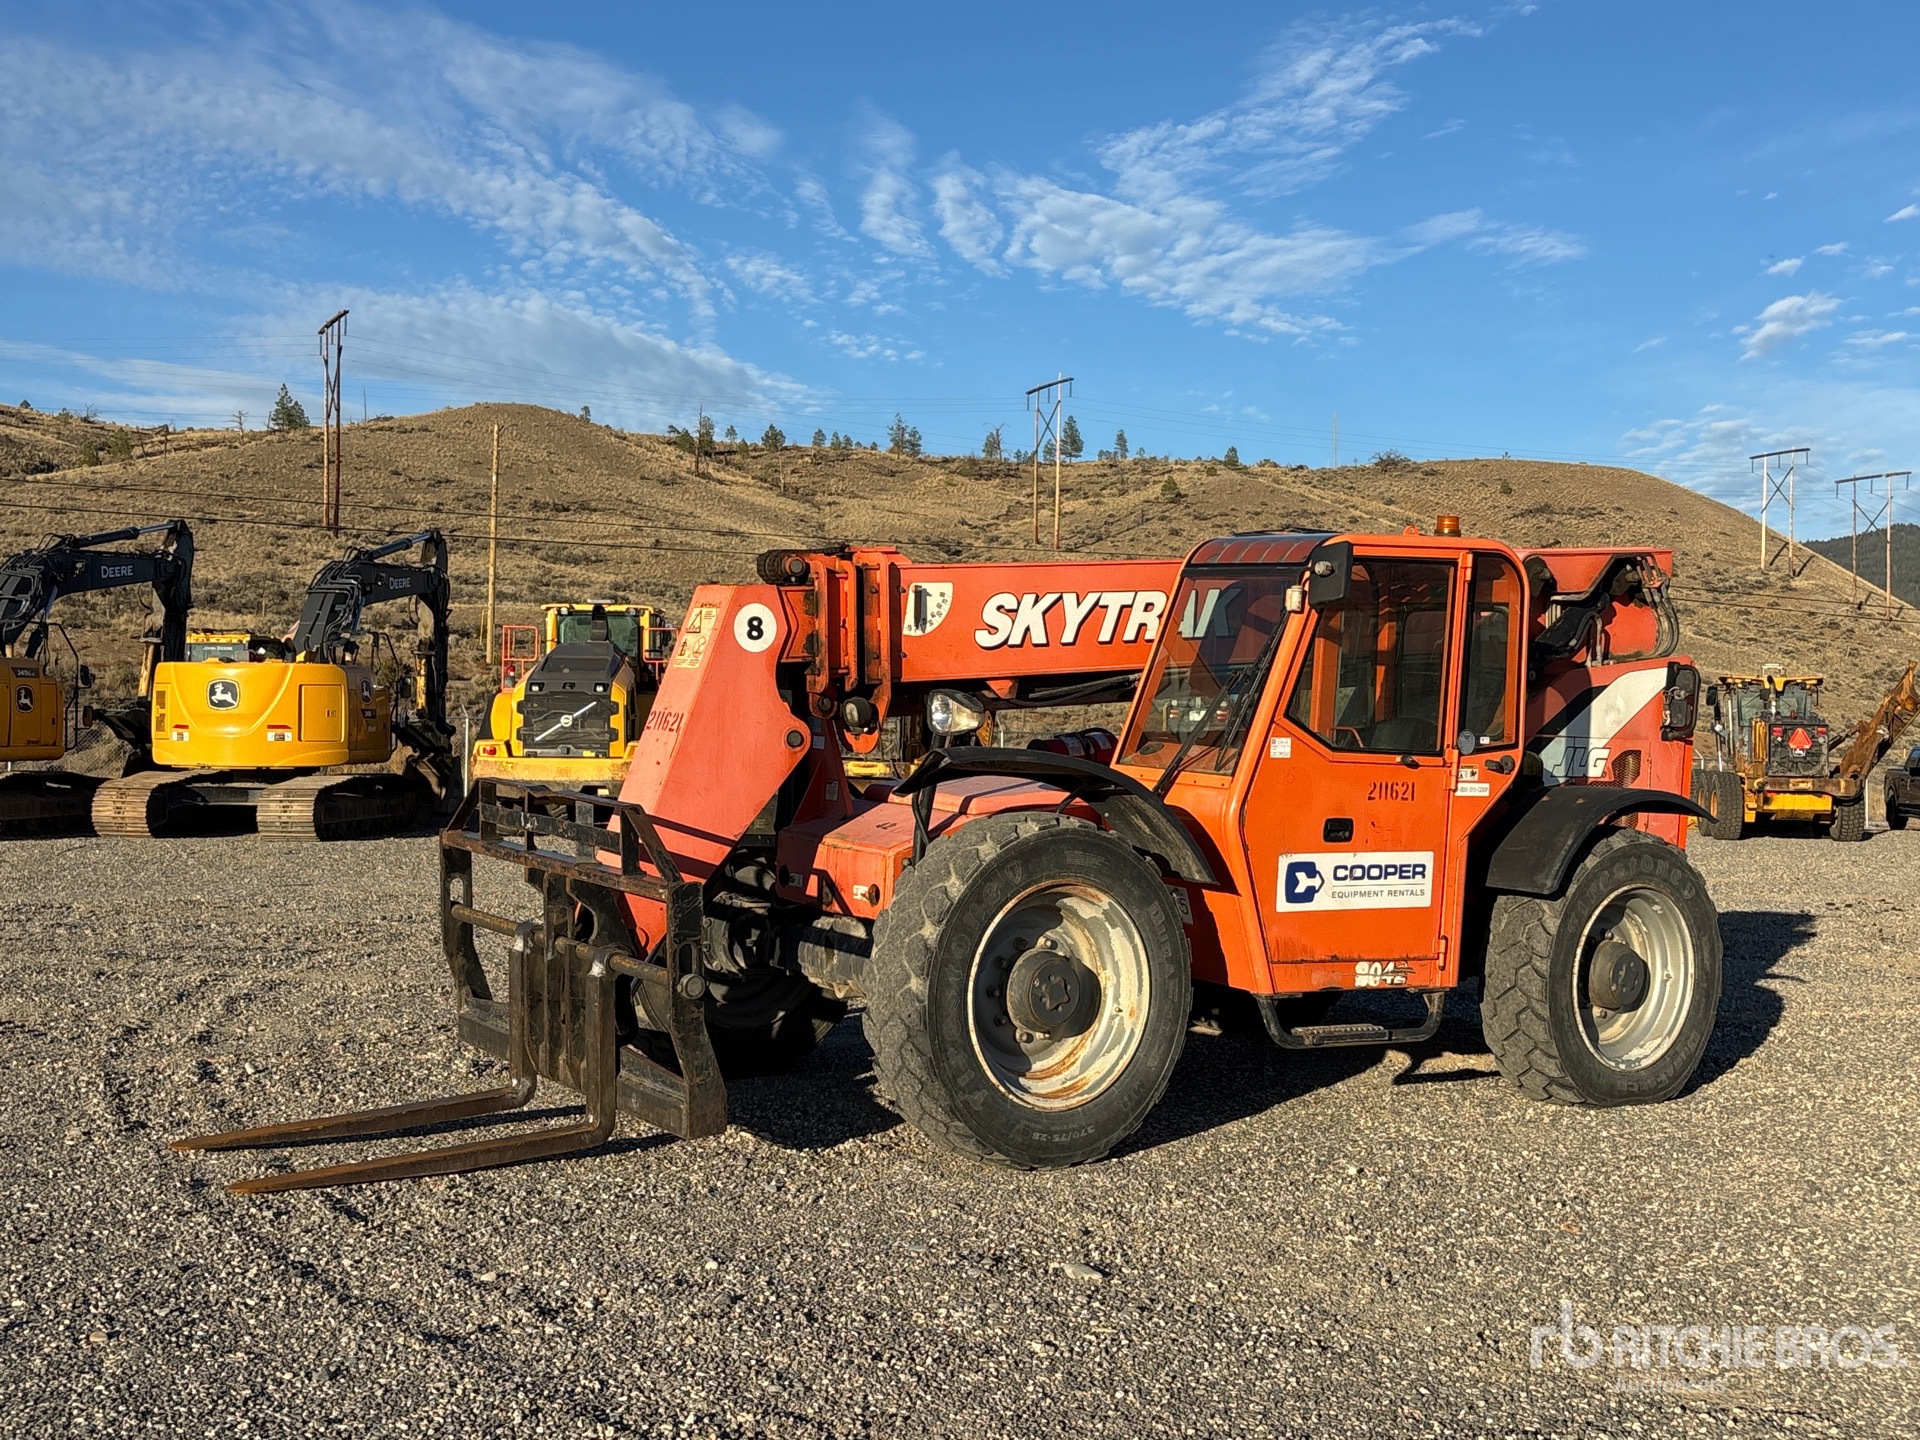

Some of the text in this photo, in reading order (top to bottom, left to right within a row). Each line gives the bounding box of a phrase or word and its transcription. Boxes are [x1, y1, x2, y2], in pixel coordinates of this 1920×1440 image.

[101, 565, 134, 579] DEERE
[389, 577, 411, 590] DEERE
[746, 616, 764, 641] 8
[645, 710, 684, 733] 211621
[1551, 746, 1611, 778] JLG
[1367, 781, 1416, 802] 211621
[1332, 863, 1427, 881] COOPER
[1331, 888, 1426, 899] EQUIPMENT RENTALS
